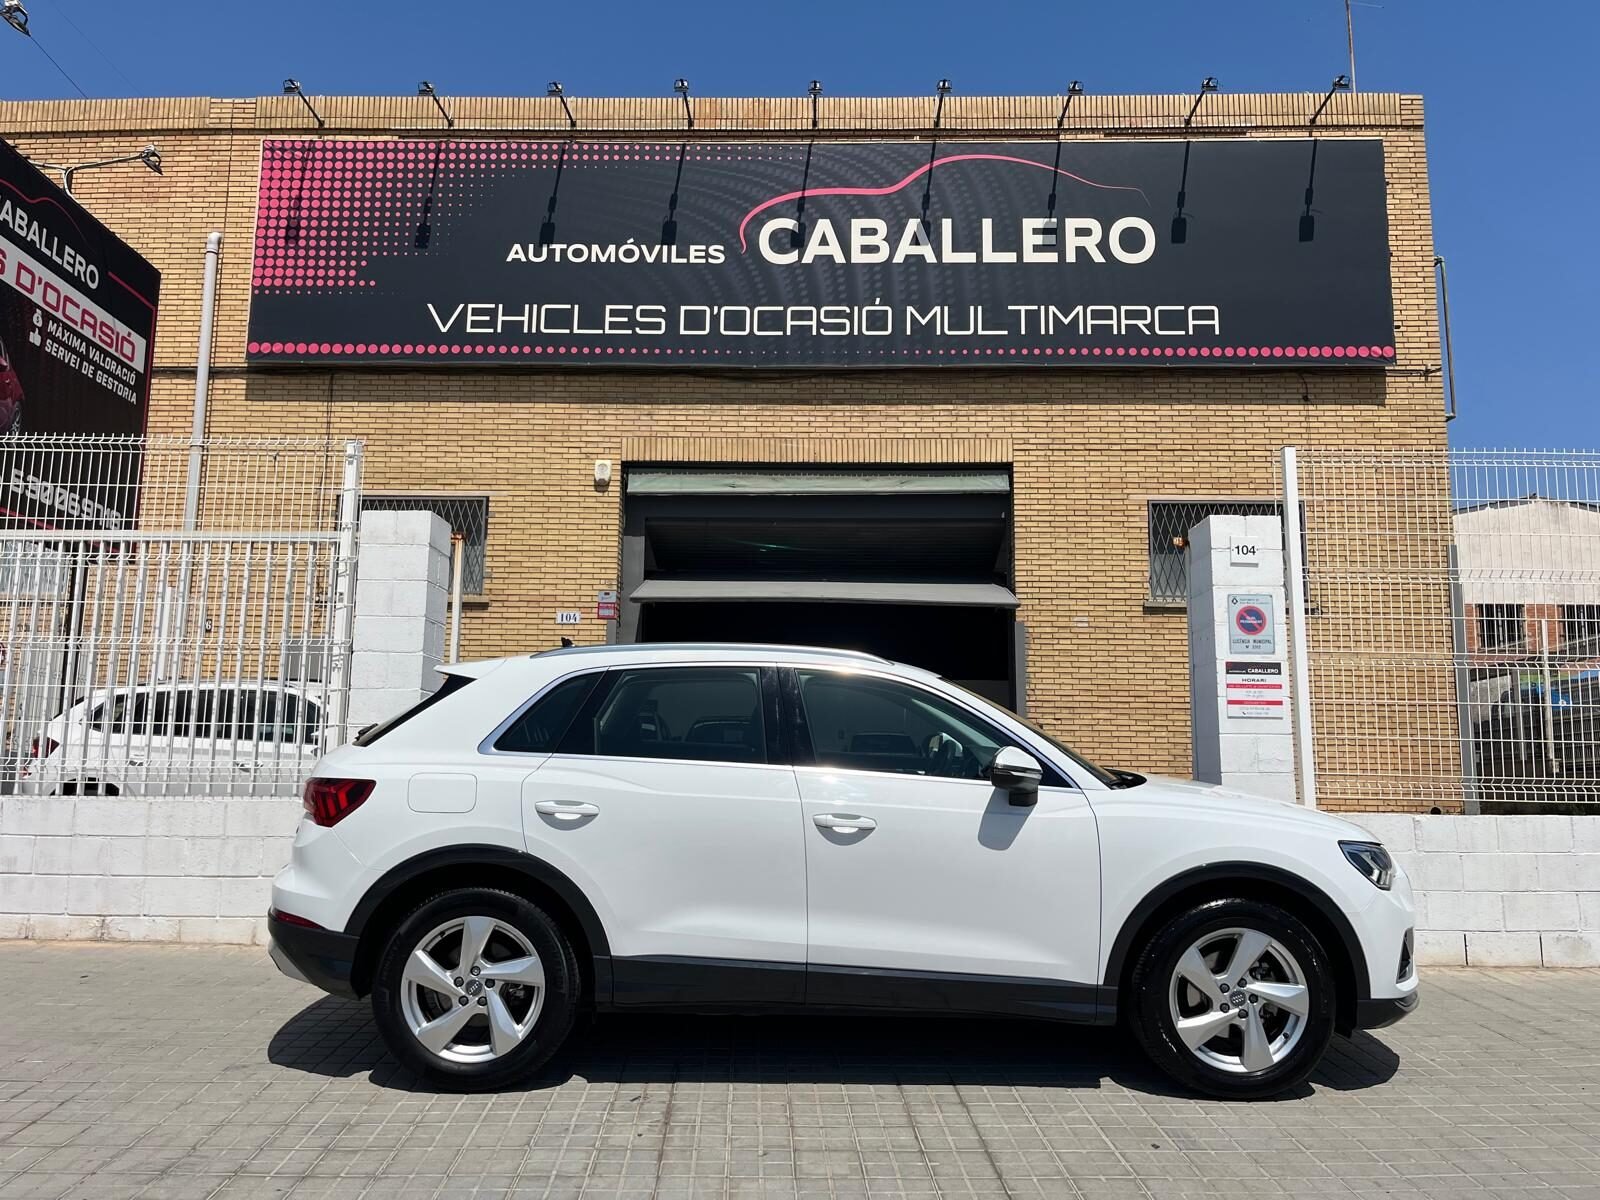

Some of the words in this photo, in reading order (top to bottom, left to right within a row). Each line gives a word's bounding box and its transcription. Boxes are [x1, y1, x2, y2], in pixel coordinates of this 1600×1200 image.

[0, 195, 99, 289] ABALLERO
[506, 238, 726, 264] AUTOMÓVILES
[758, 216, 1157, 265] CABALLERO
[15, 260, 136, 364] D'OCASIÓ
[426, 303, 667, 335] VEHICLES
[679, 298, 893, 336] D'OCASIÓ
[906, 305, 1220, 336] MULTIMARCA
[44, 338, 81, 370] SERVEI
[81, 361, 95, 378] DE
[95, 370, 137, 405] GESTORIA
[89, 346, 137, 386] VALORACIÓ
[1234, 545, 1257, 555] 104
[560, 613, 577, 622] 104
